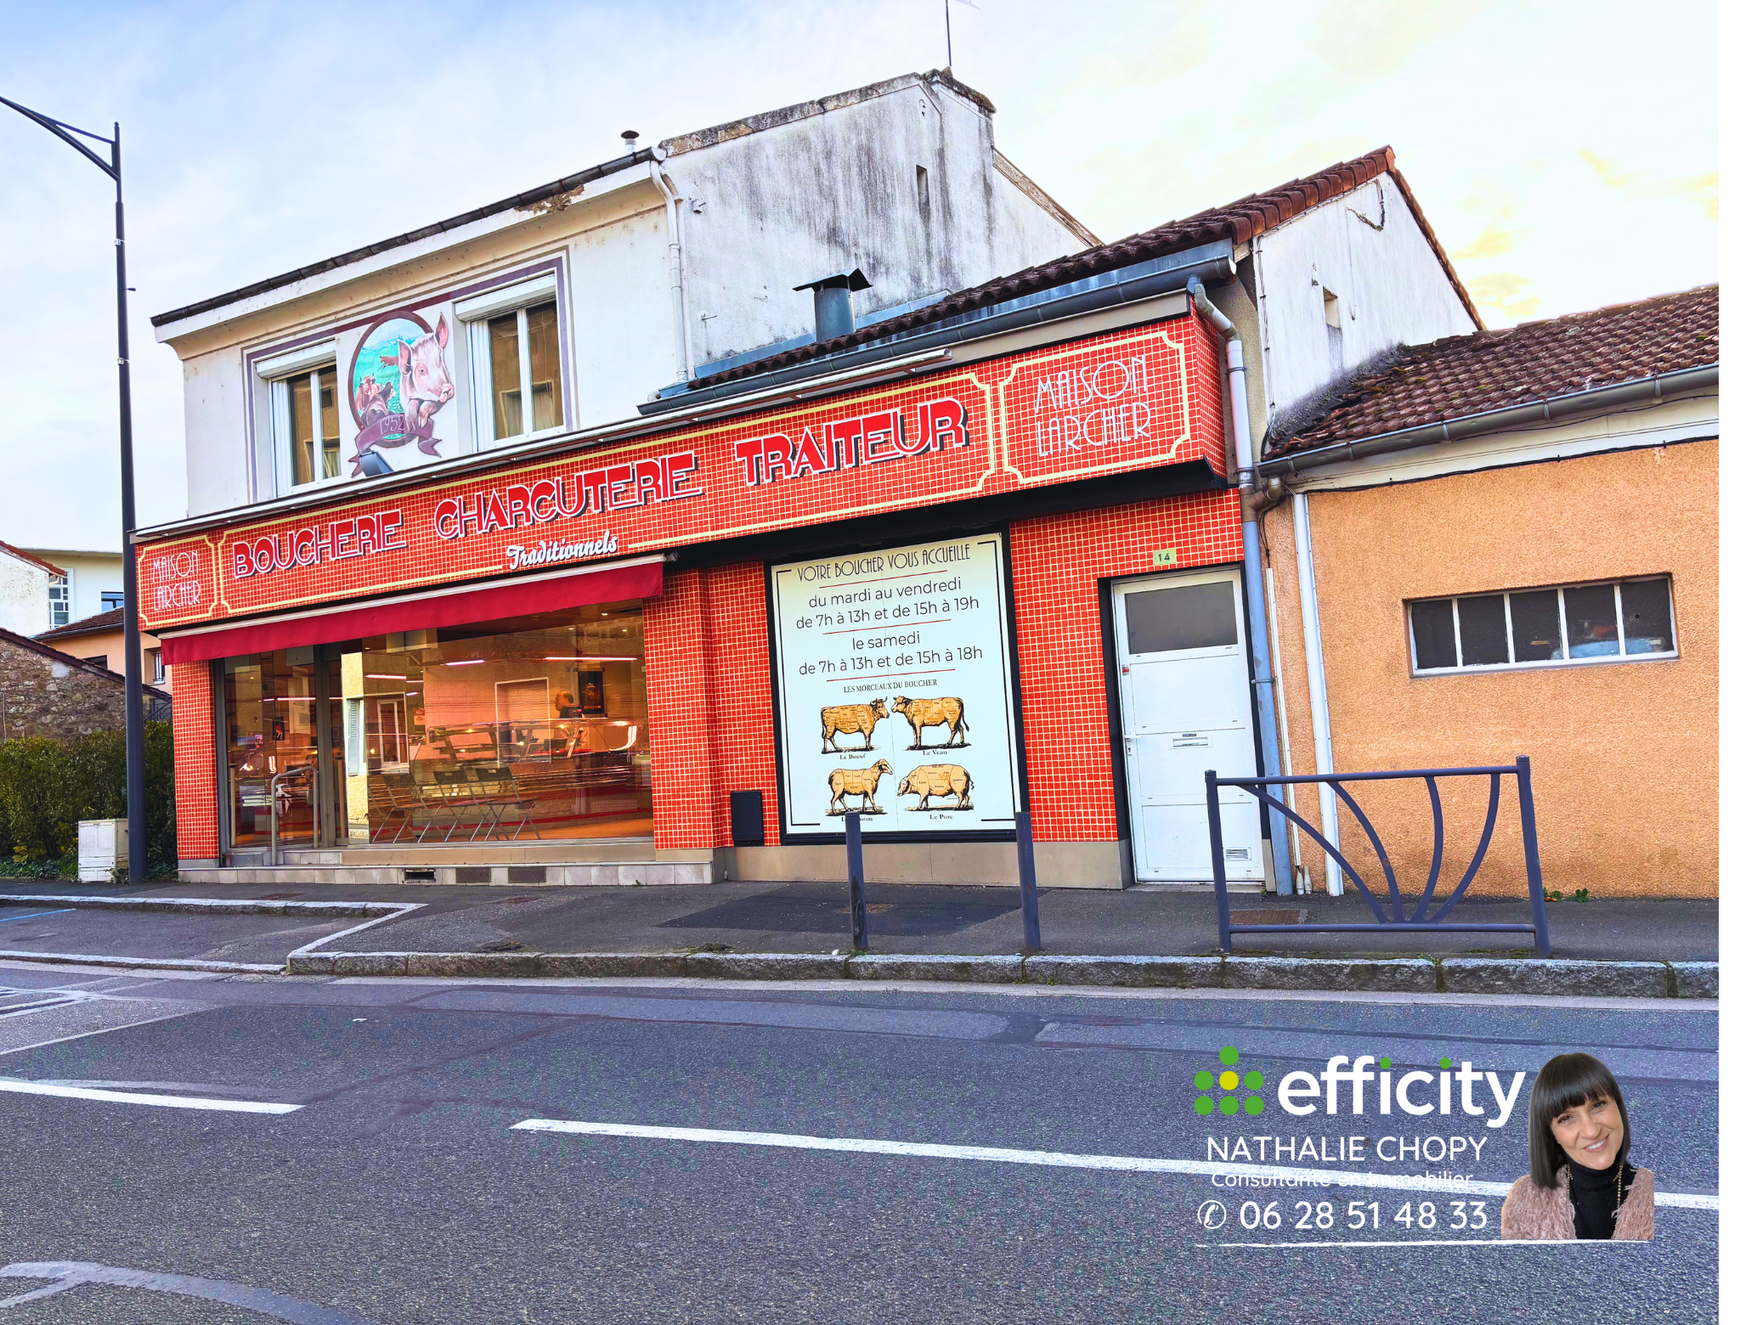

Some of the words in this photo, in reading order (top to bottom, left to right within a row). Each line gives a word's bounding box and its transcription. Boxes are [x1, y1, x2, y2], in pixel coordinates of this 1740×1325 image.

[1035, 354, 1148, 414] MAISON
[379, 414, 406, 434] 1952
[1037, 402, 1151, 457] LARCHER
[233, 509, 407, 578] BOUCHERIE
[434, 450, 702, 539] CHARCUTERIE
[734, 397, 967, 486] TRAITEUR
[152, 550, 198, 582] MAISON
[506, 530, 618, 570] Traditionnels
[797, 563, 832, 582] VOTRE
[834, 556, 884, 578] BOUCHER
[888, 551, 919, 570] VOUS
[922, 544, 971, 565] ACCUEILLE
[1158, 552, 1170, 562] 14
[154, 580, 200, 611] LARCHER
[808, 594, 826, 608] du
[831, 588, 872, 605] mardi
[875, 589, 893, 600] au
[896, 576, 962, 597] vendredi
[796, 616, 814, 630] de
[816, 613, 833, 626] 7h
[836, 612, 844, 624] à
[848, 610, 870, 623] 13h
[874, 608, 888, 620] et
[892, 604, 910, 618] de
[914, 601, 938, 616] 15h
[942, 600, 950, 612] à
[954, 596, 980, 610] 19h
[852, 637, 864, 650] le
[868, 631, 921, 648] samedi
[799, 662, 816, 676] de
[818, 660, 836, 673] 7h
[840, 658, 848, 671] à
[850, 656, 872, 670] 13h
[877, 656, 891, 668] et
[896, 652, 914, 666] de
[917, 650, 941, 664] 15h
[945, 648, 954, 661] à
[957, 646, 983, 661] 18h
[856, 682, 892, 692] MORCEAUX
[904, 679, 938, 688] BOUCHER
